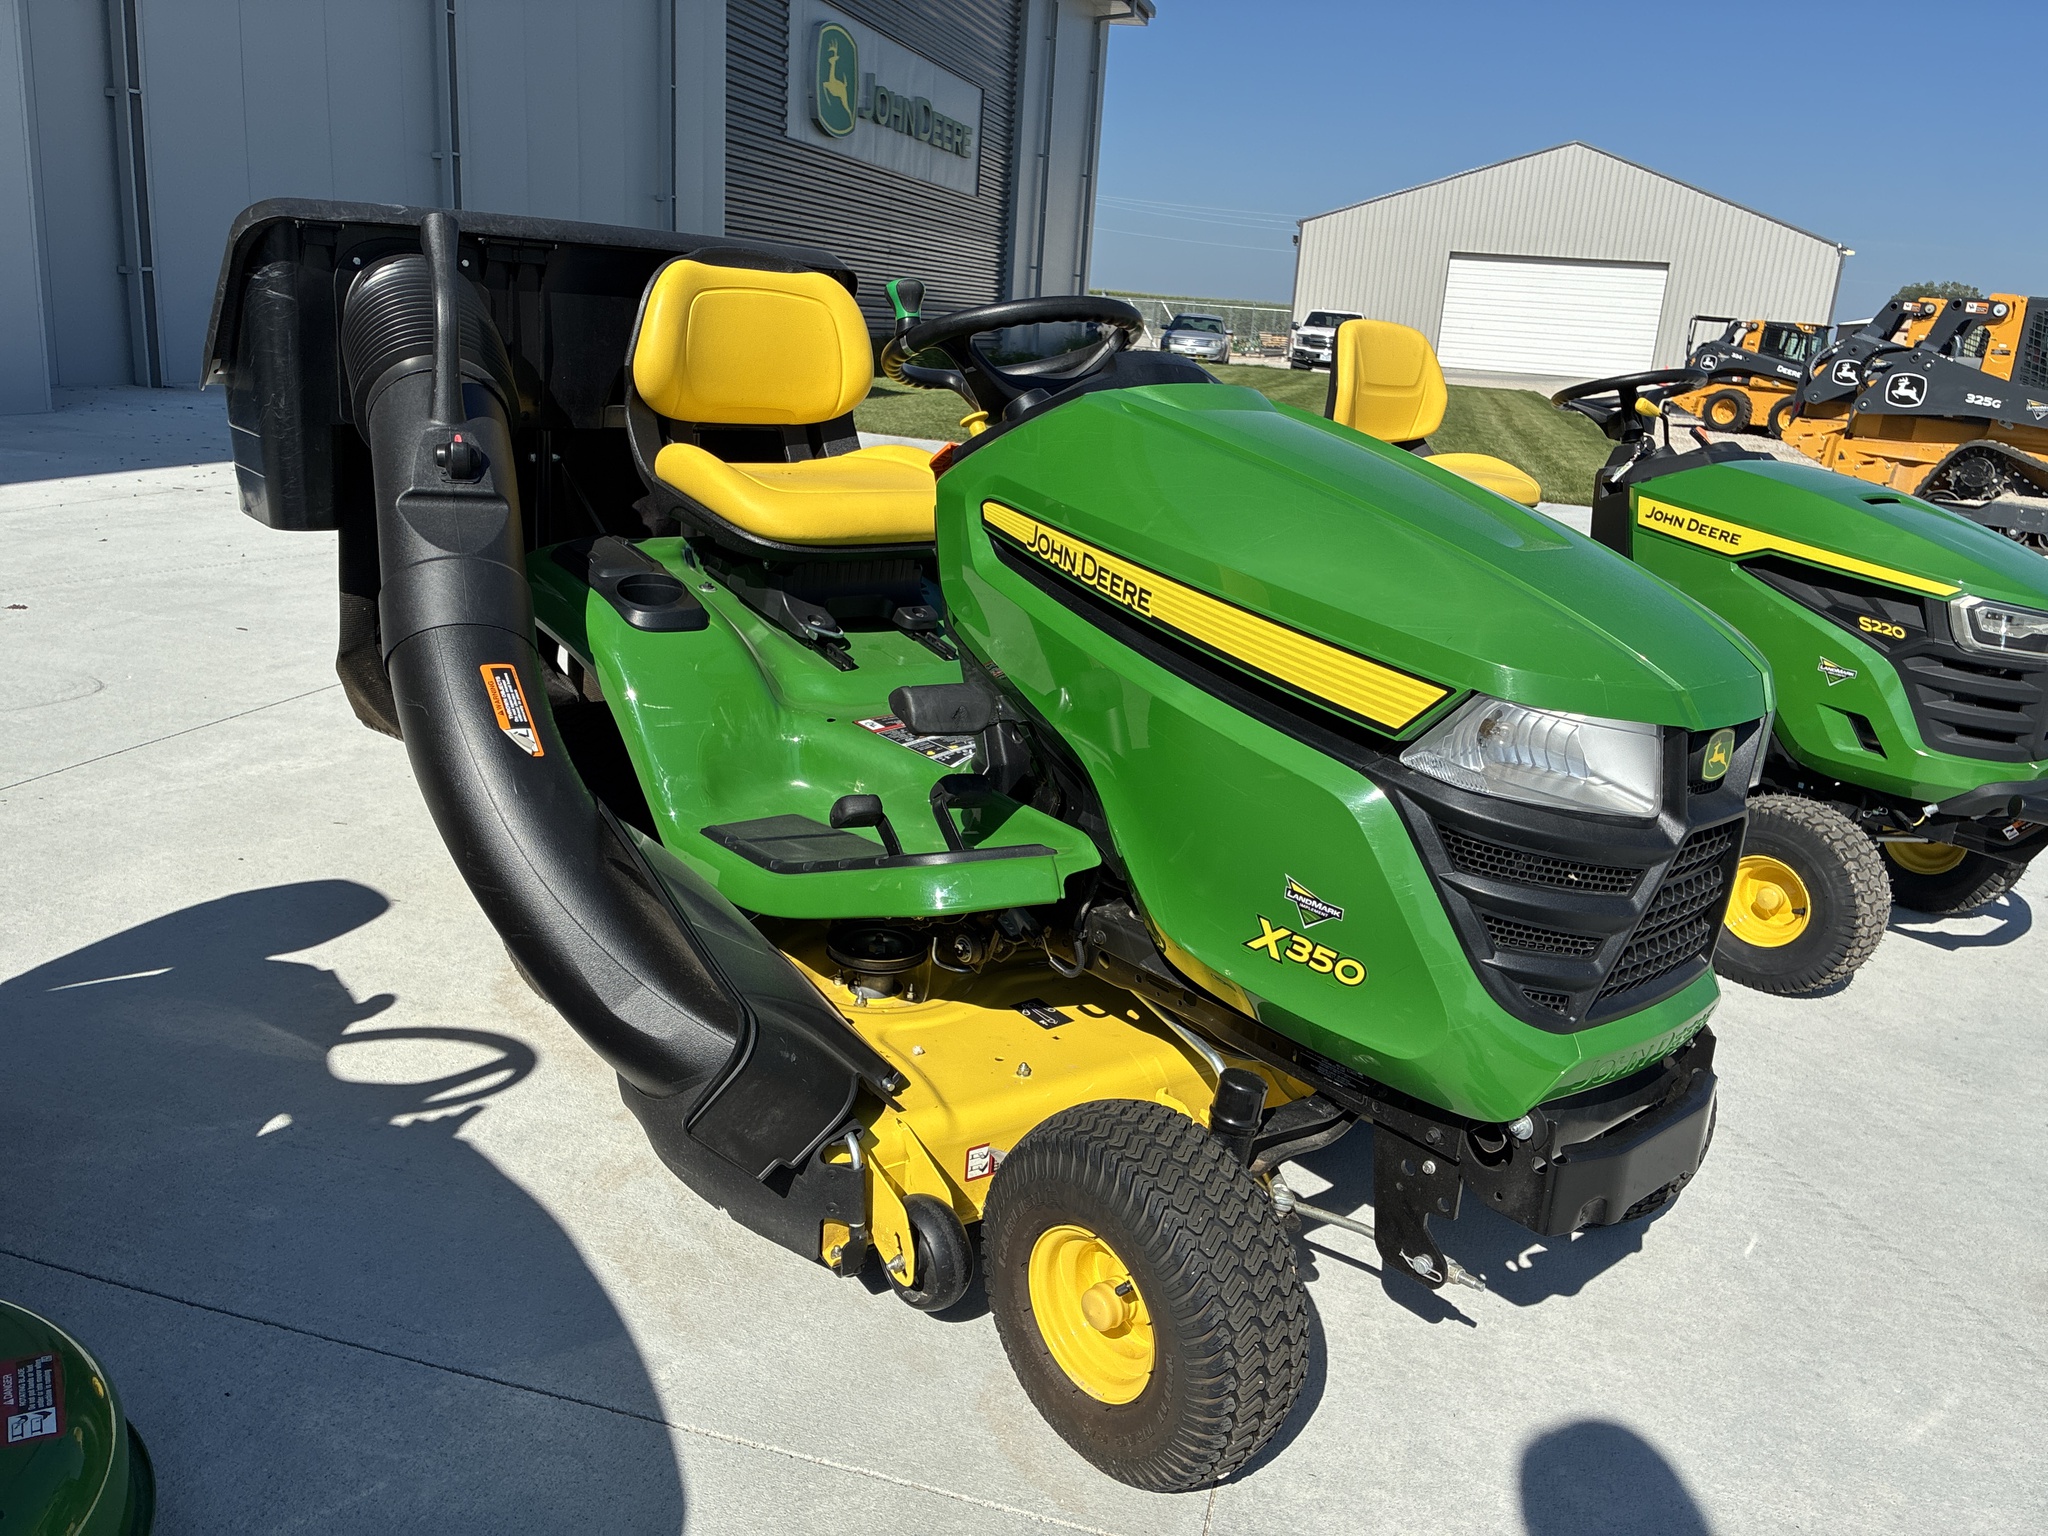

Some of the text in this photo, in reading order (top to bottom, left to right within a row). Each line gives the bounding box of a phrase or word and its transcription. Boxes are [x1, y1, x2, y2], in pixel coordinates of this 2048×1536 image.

[858, 72, 973, 159] JOHN DEERE
[1965, 393, 2002, 409] 325G
[1645, 506, 1742, 546] JOHN DEERE
[1026, 525, 1152, 613] JOHN DEERE
[1858, 616, 1906, 639] S220
[488, 680, 504, 711] WARNING
[1287, 889, 1341, 918] LANDMARK
[1299, 903, 1329, 918] IMPLEMENT
[1243, 915, 1366, 986] X350
[3, 1373, 13, 1399] DANGER
